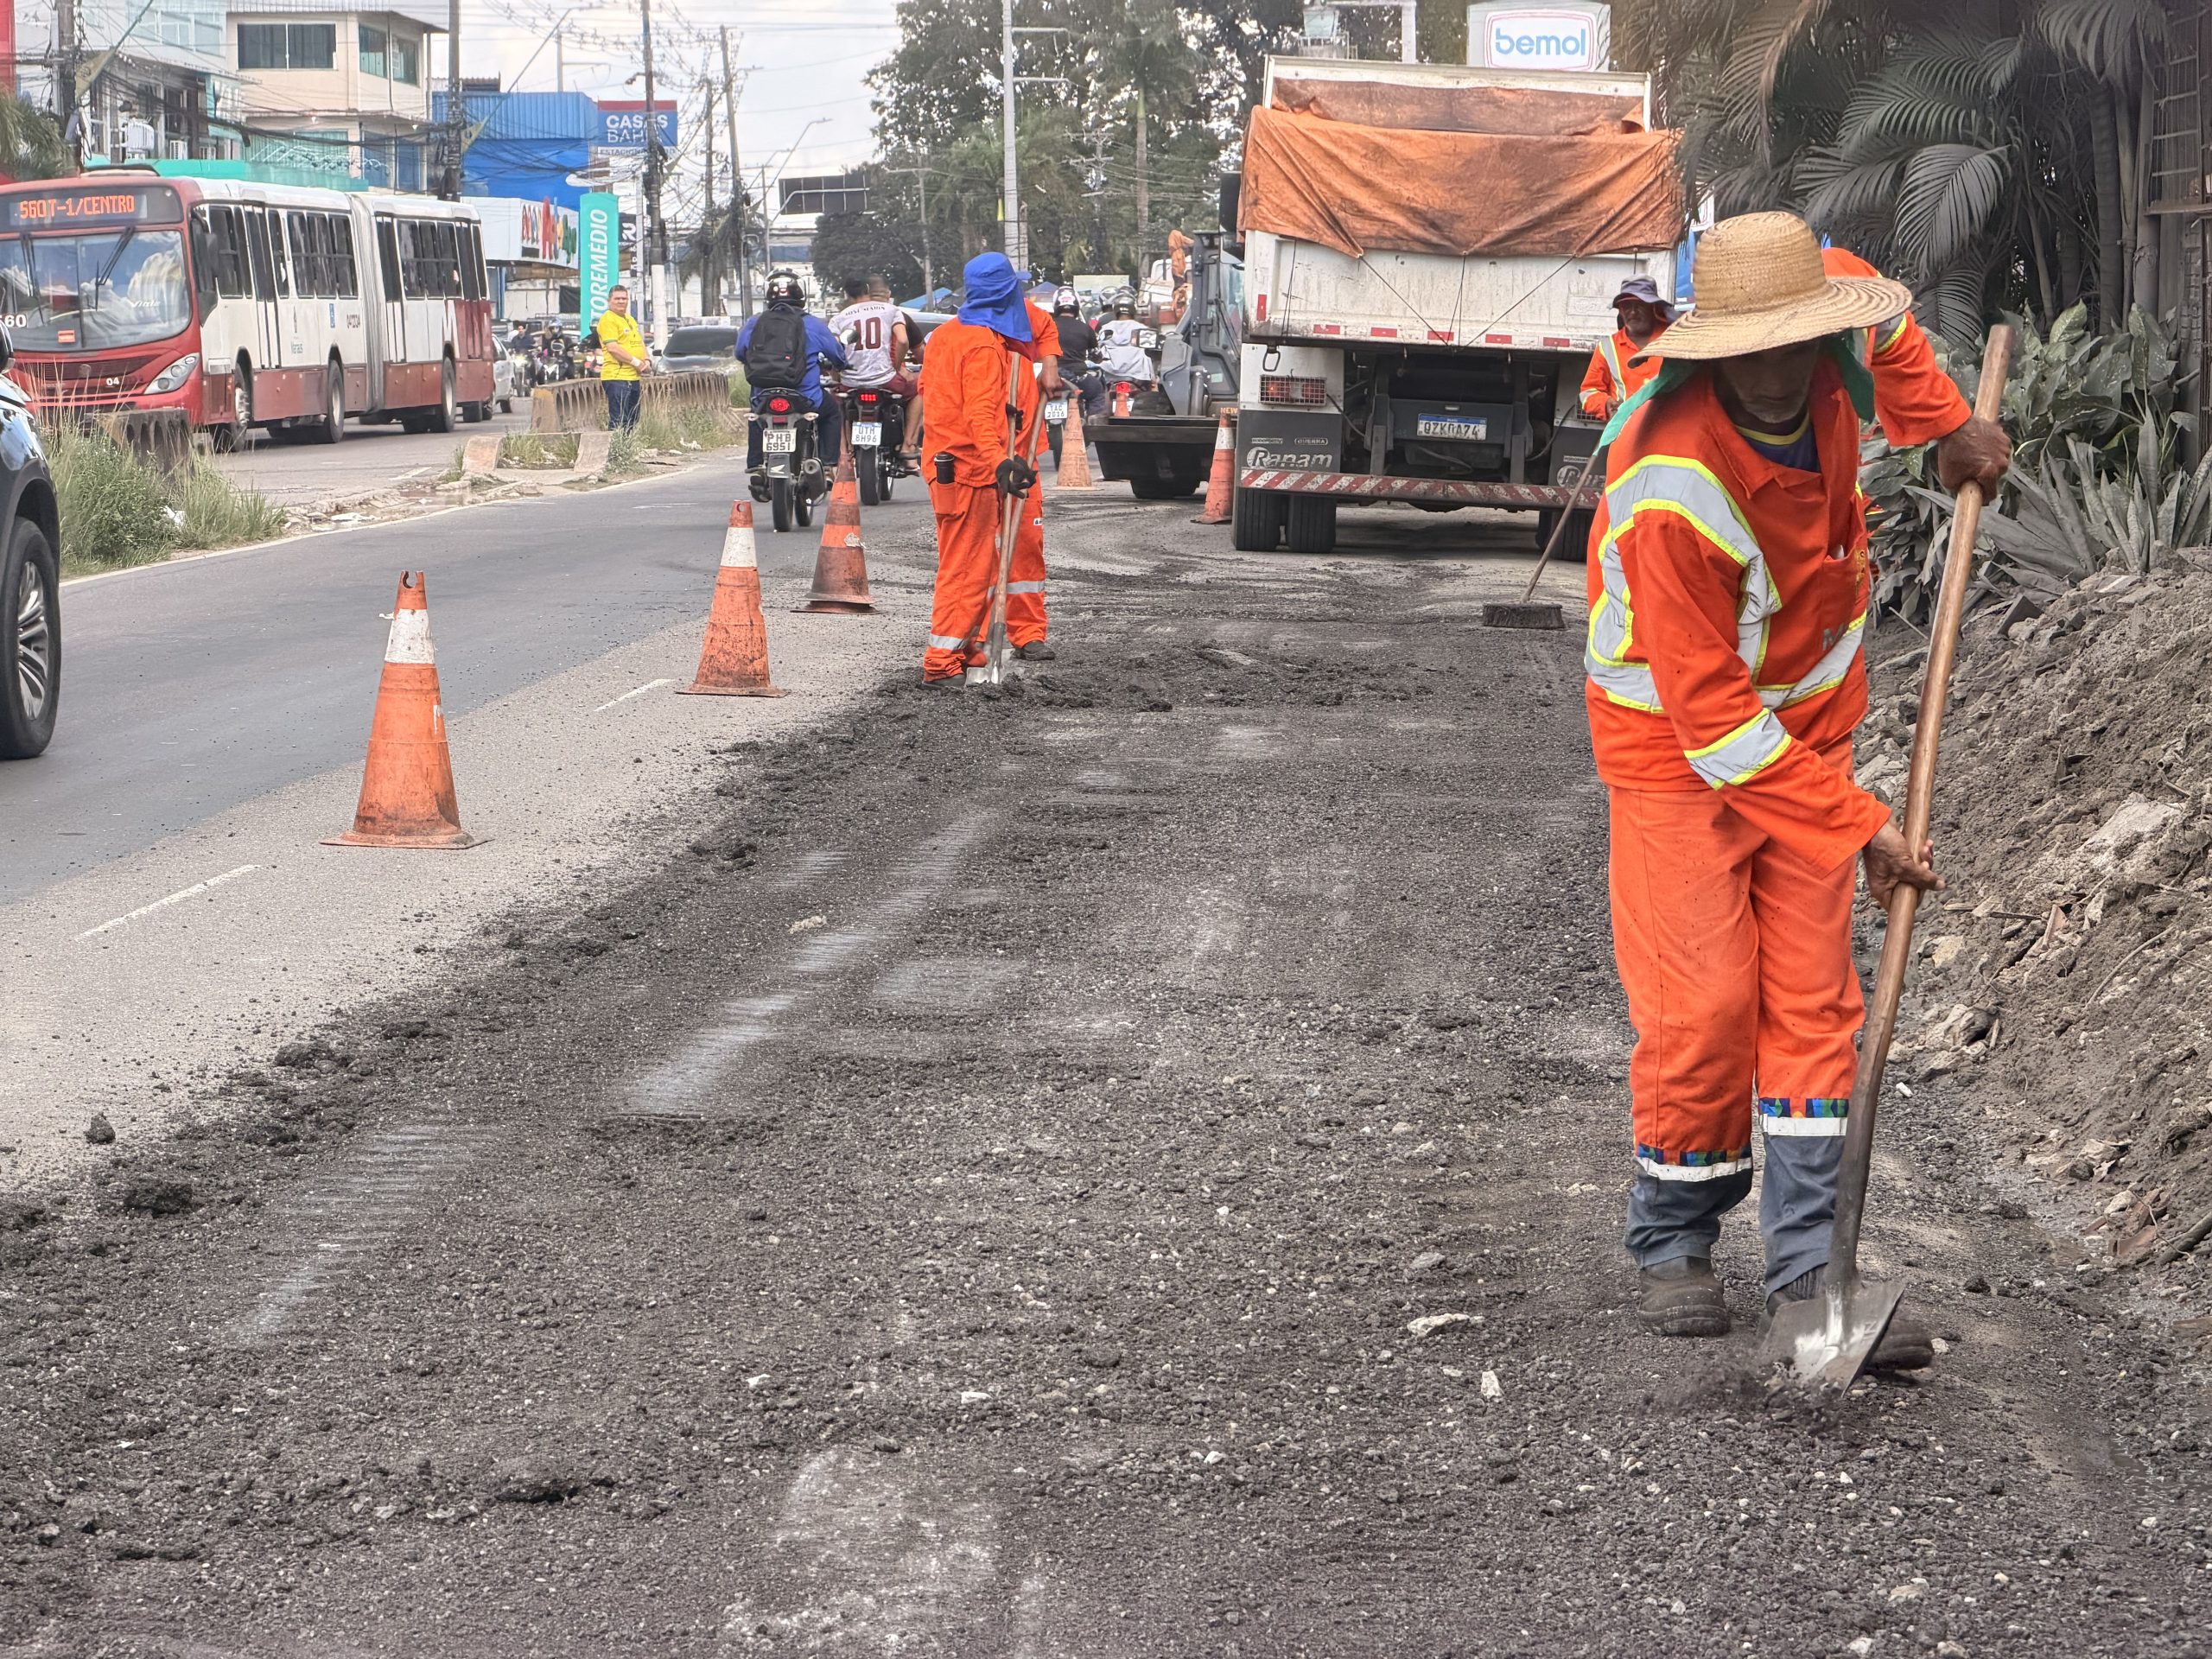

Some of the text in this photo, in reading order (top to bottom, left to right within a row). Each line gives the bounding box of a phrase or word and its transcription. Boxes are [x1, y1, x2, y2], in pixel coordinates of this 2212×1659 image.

[1495, 28, 1586, 55] bemol
[607, 129, 663, 143] BAH
[854, 316, 881, 351] 10
[106, 378, 120, 386] 04
[767, 433, 791, 442] PHB
[766, 442, 791, 451] 6951
[1249, 448, 1333, 467] Ranam
